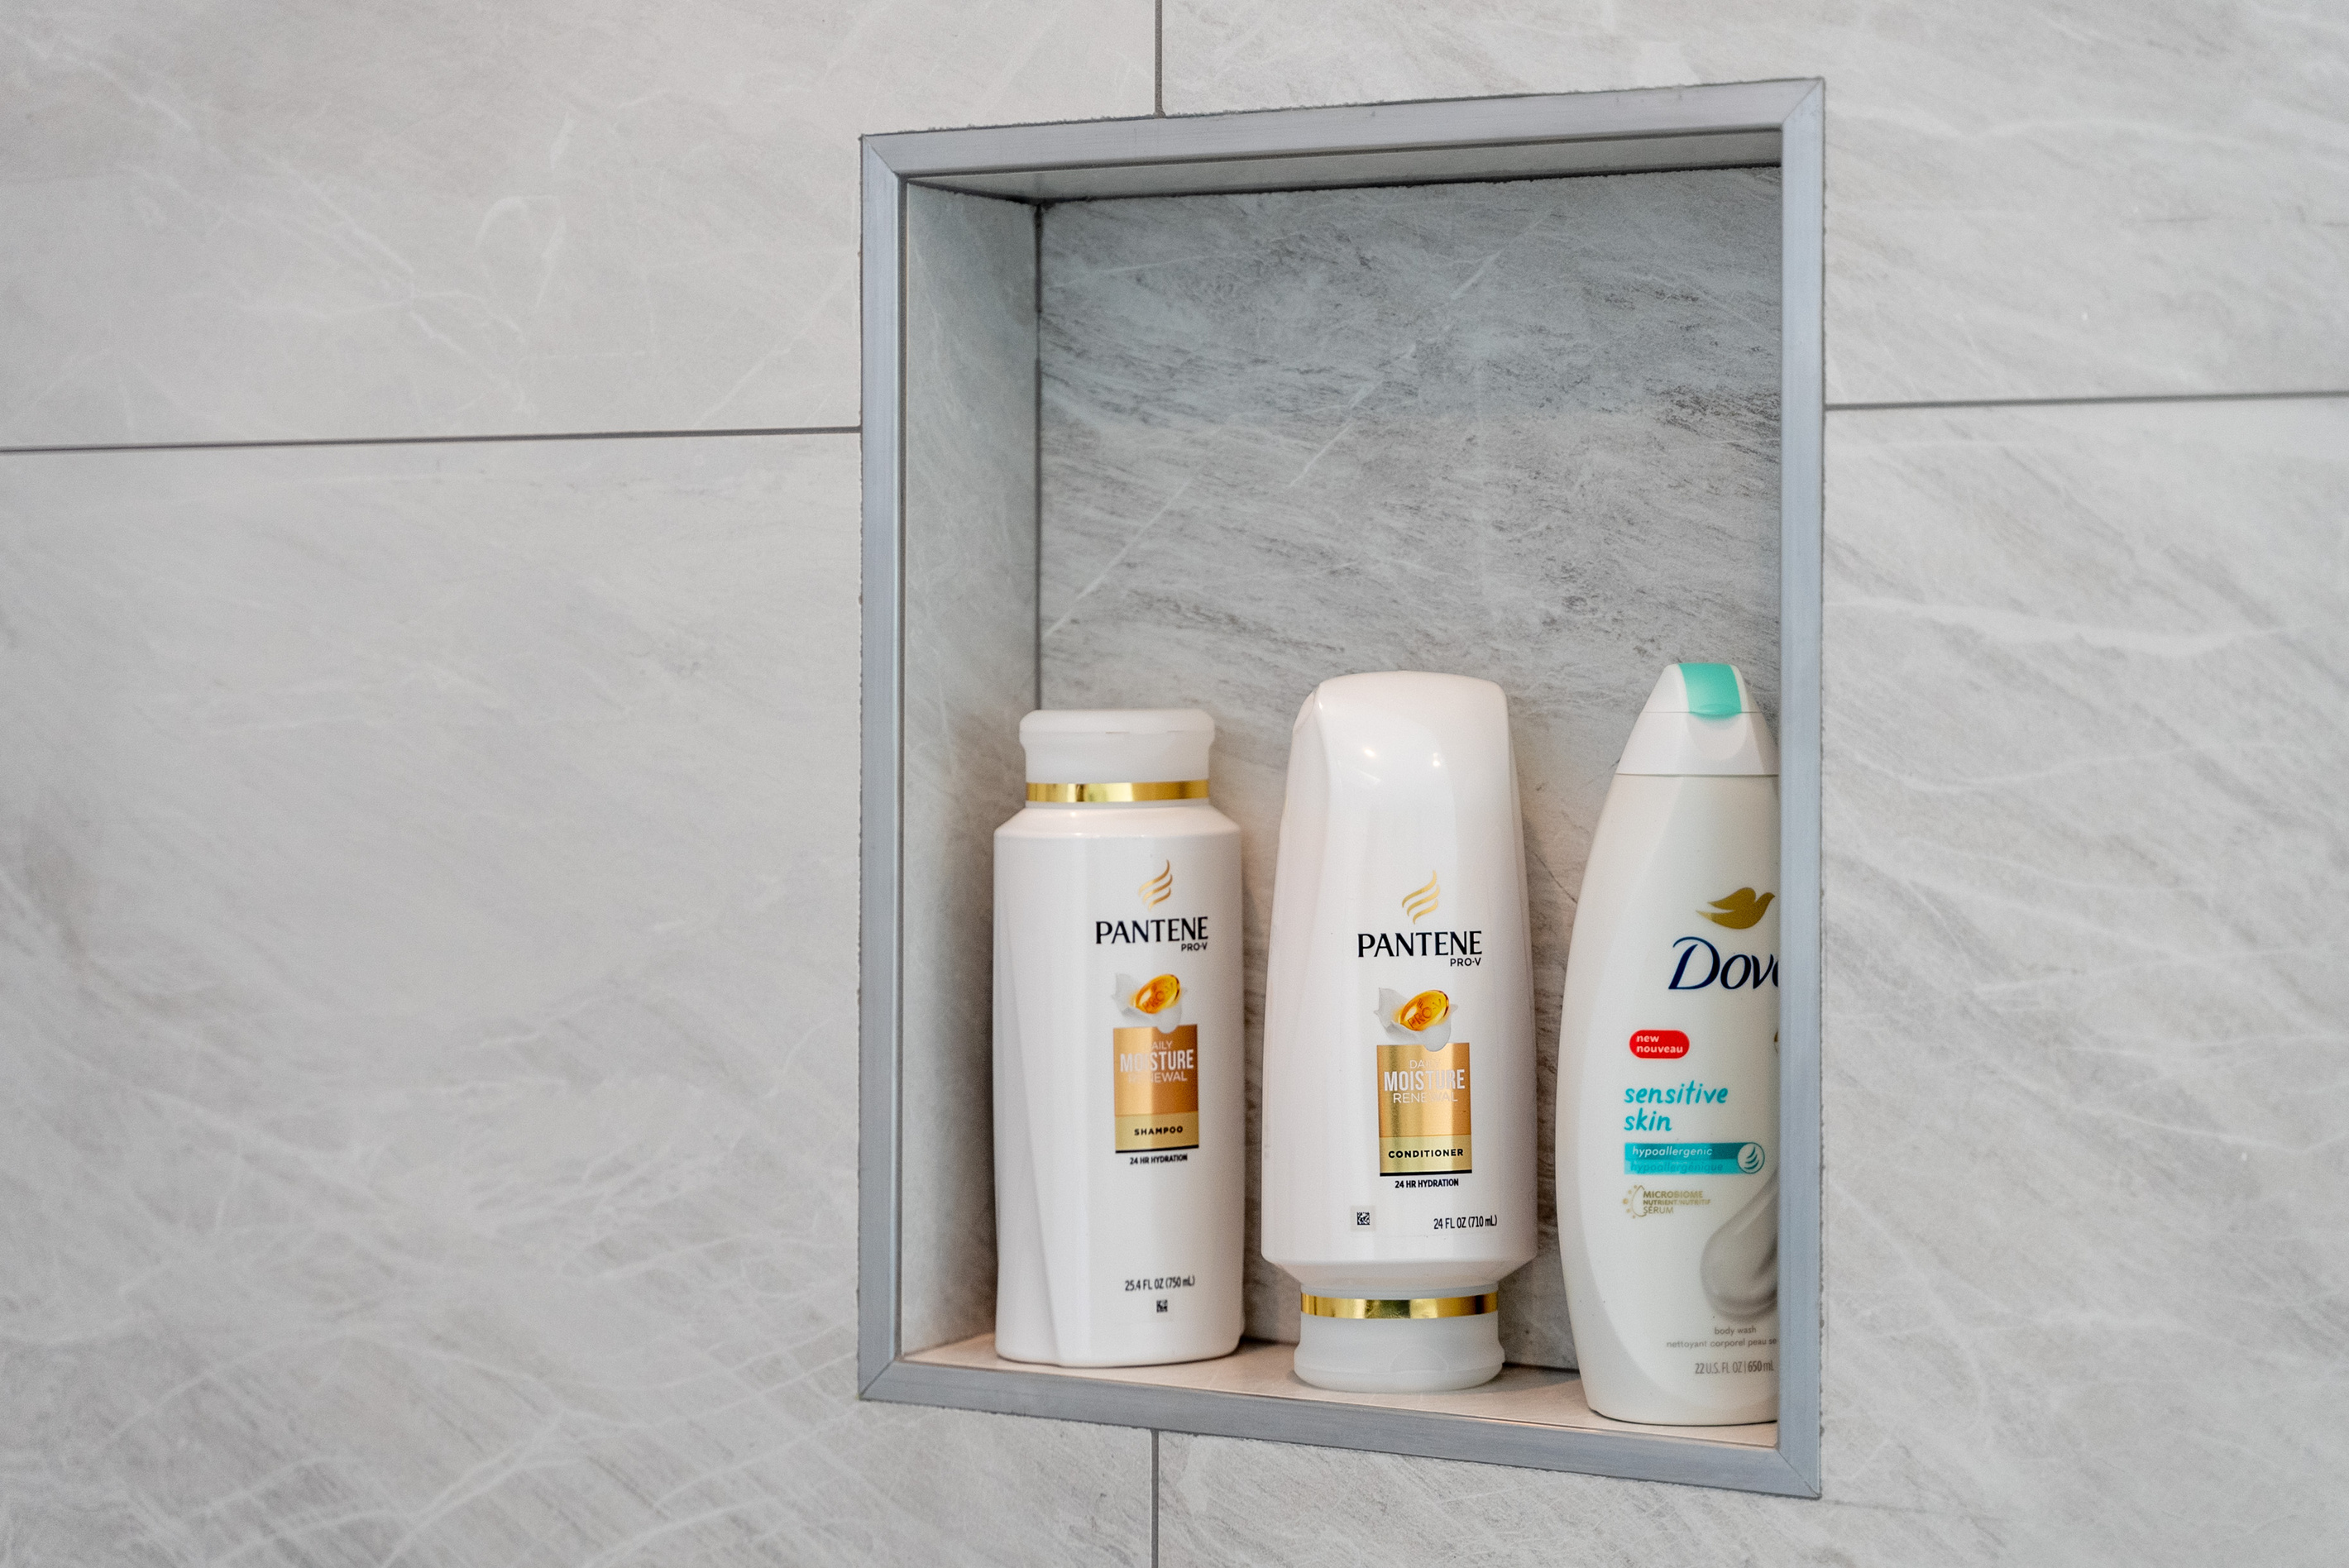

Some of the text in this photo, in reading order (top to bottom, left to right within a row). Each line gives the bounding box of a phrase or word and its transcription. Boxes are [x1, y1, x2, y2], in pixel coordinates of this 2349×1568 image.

[1095, 916, 1208, 944] PANTENE
[1357, 930, 1482, 957] PANTENE
[1636, 1035, 1659, 1043] new
[1636, 1045, 1683, 1054] nouveau
[1120, 1049, 1194, 1073] MOISTURE
[1384, 1069, 1466, 1092] MOISTURE
[1624, 1080, 1729, 1105] sensitive
[1624, 1108, 1672, 1131] skin
[1134, 1126, 1184, 1135] SHAMPOO
[1388, 1149, 1464, 1159] CONDITIONER
[1632, 1146, 1713, 1157] hypoallergenic
[1151, 1154, 1188, 1164] HYDRATION
[1418, 1178, 1459, 1188] HYDRATION
[1433, 1215, 1498, 1230] 24 FL OZ (710 mL)
[1125, 1280, 1141, 1291] 25.4
[1143, 1279, 1152, 1289] FL
[1155, 1279, 1164, 1288] OZ
[1165, 1277, 1181, 1288] (750
[1715, 1327, 1734, 1336] body
[1667, 1340, 1707, 1349] nettoyant
[1710, 1338, 1745, 1348] corporel
[1696, 1363, 1705, 1374] 22
[1706, 1362, 1720, 1374] U.S.
[1722, 1362, 1730, 1373] FL
[1733, 1362, 1742, 1372] OZ
[1748, 1360, 1762, 1372] 650
